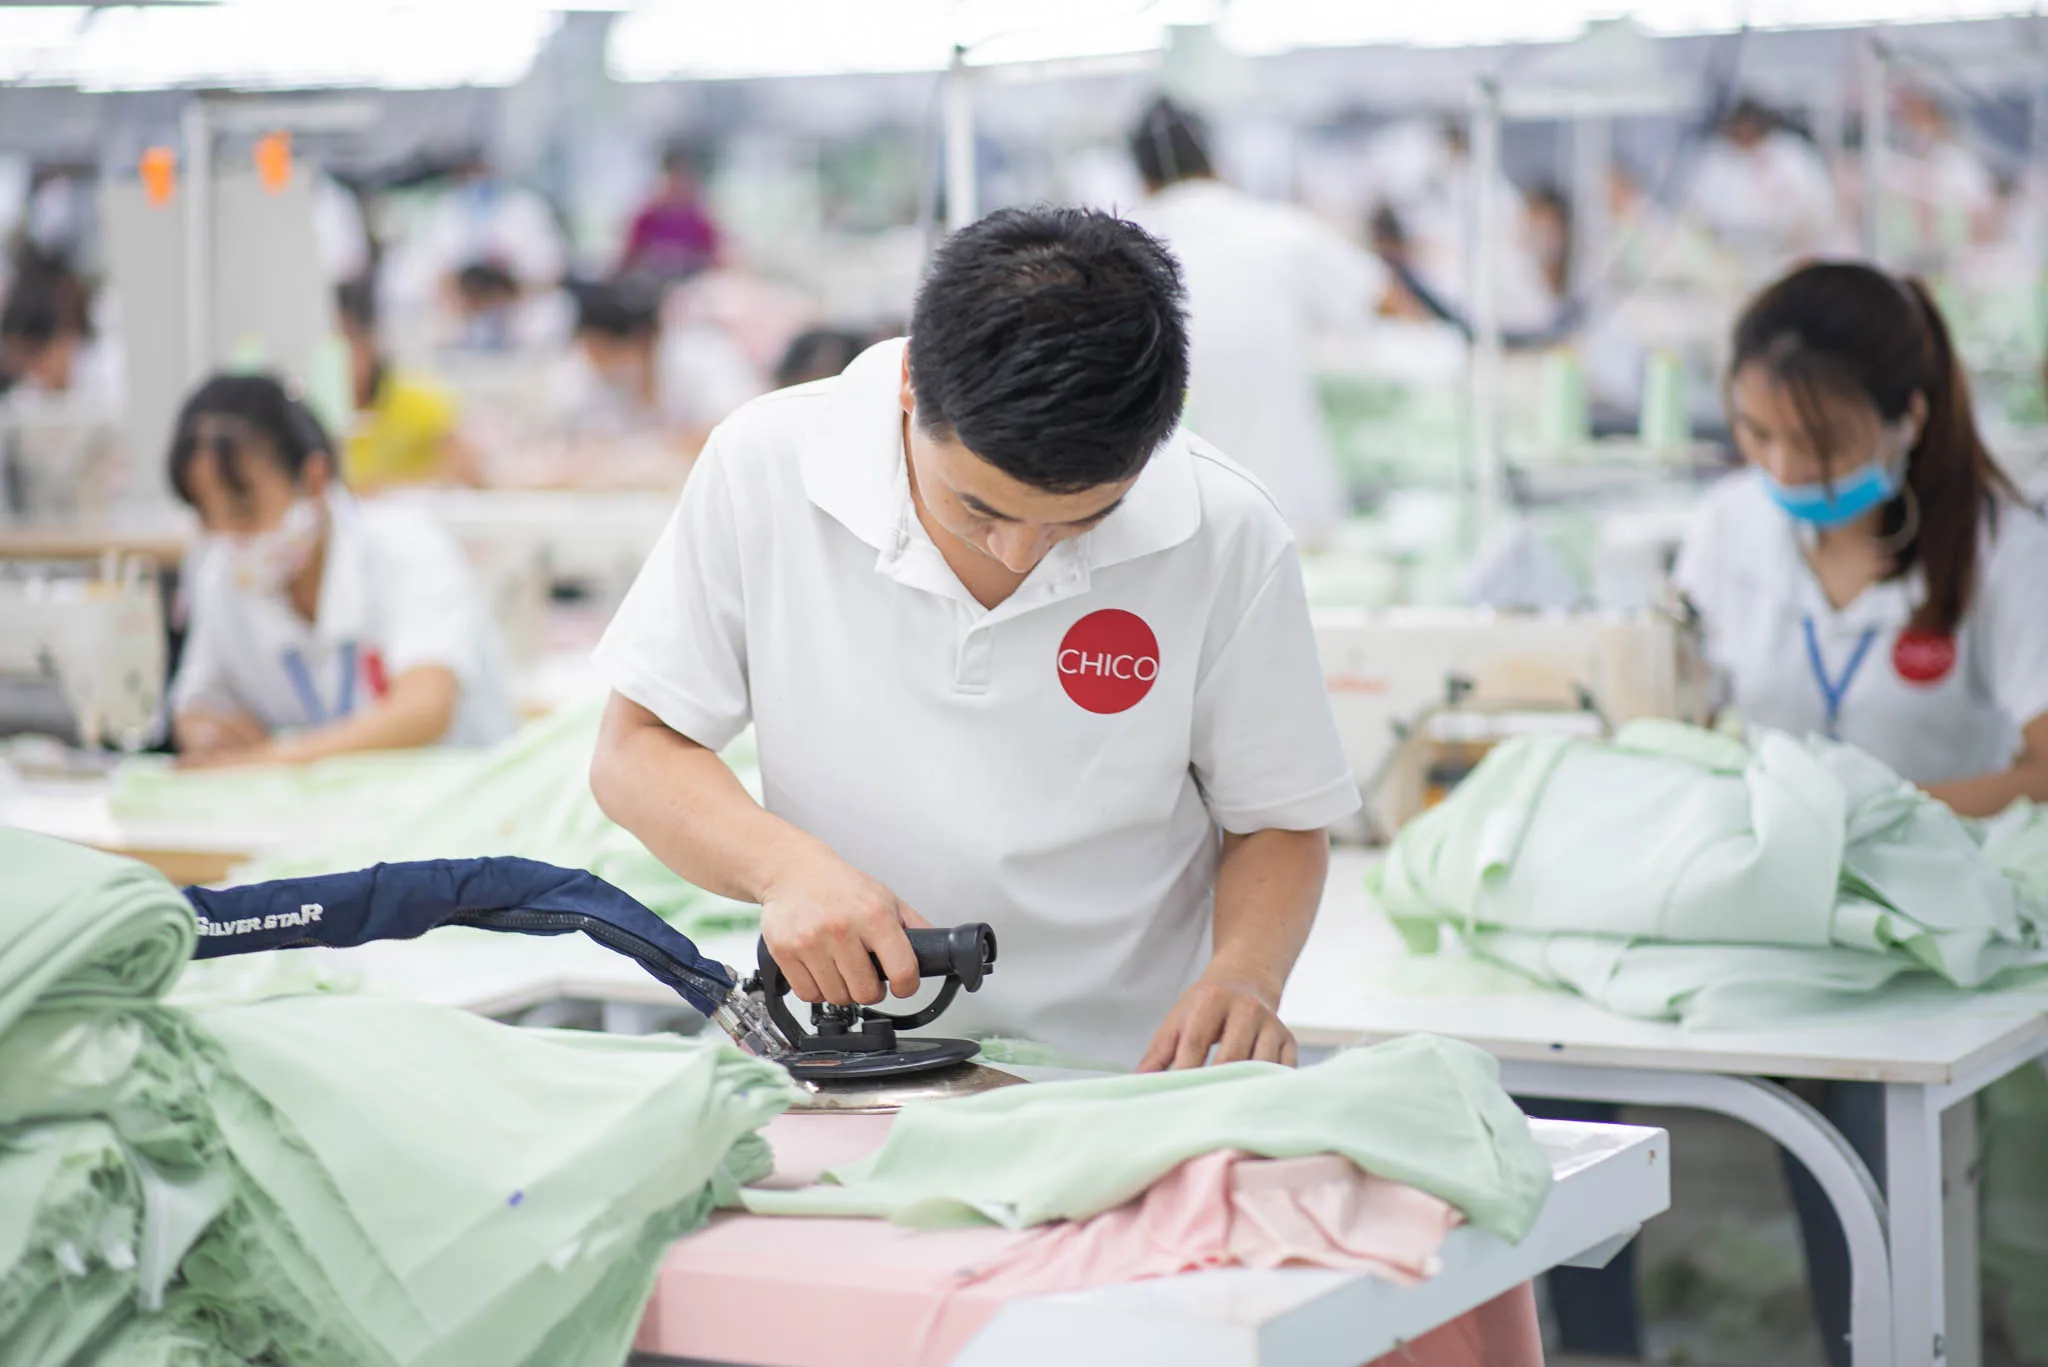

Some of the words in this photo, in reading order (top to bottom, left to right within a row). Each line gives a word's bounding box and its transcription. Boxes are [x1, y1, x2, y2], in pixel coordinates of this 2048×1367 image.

[1058, 649, 1158, 681] CHICO
[196, 917, 261, 936] SILVER
[263, 903, 323, 929] STAR
